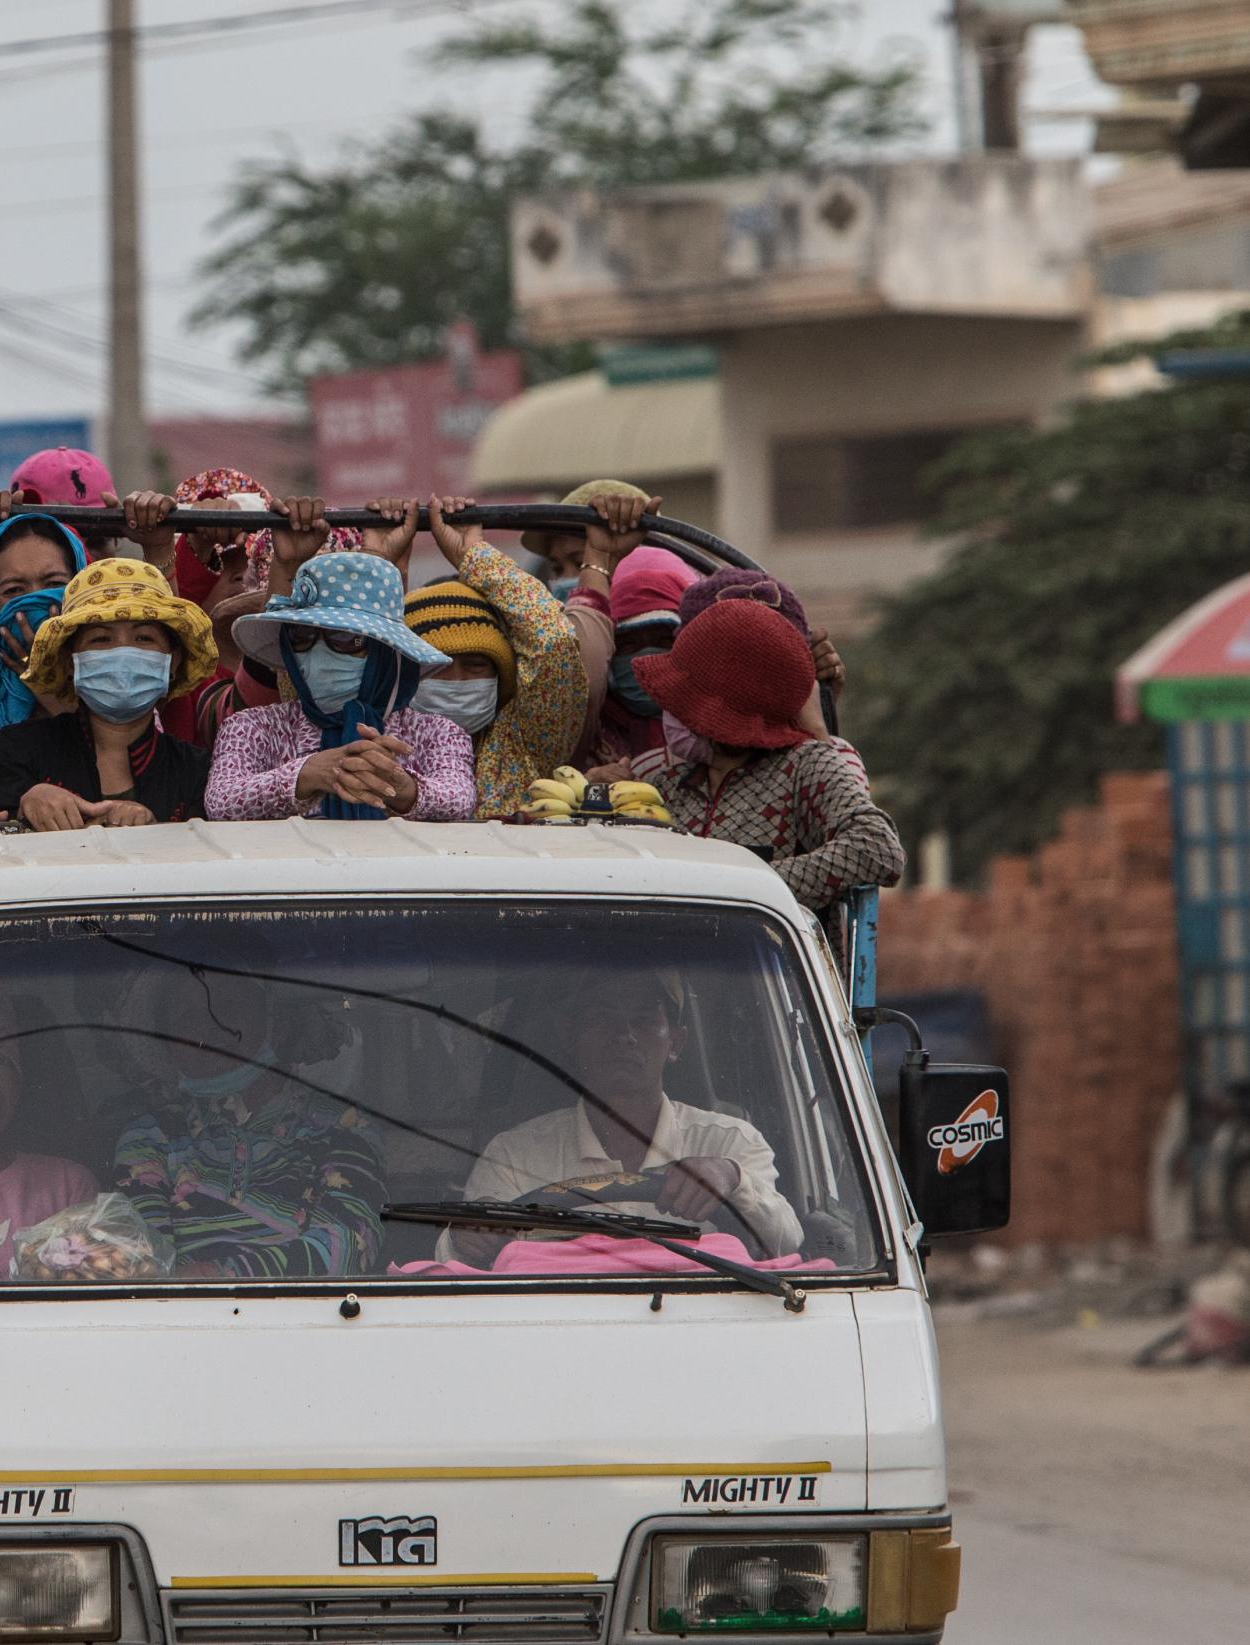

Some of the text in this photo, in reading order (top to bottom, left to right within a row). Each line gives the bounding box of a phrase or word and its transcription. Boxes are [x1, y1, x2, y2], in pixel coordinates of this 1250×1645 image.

[929, 1118, 1002, 1147] COSMIC
[50, 1488, 73, 1513] II
[681, 1476, 818, 1505] MIGHTY II
